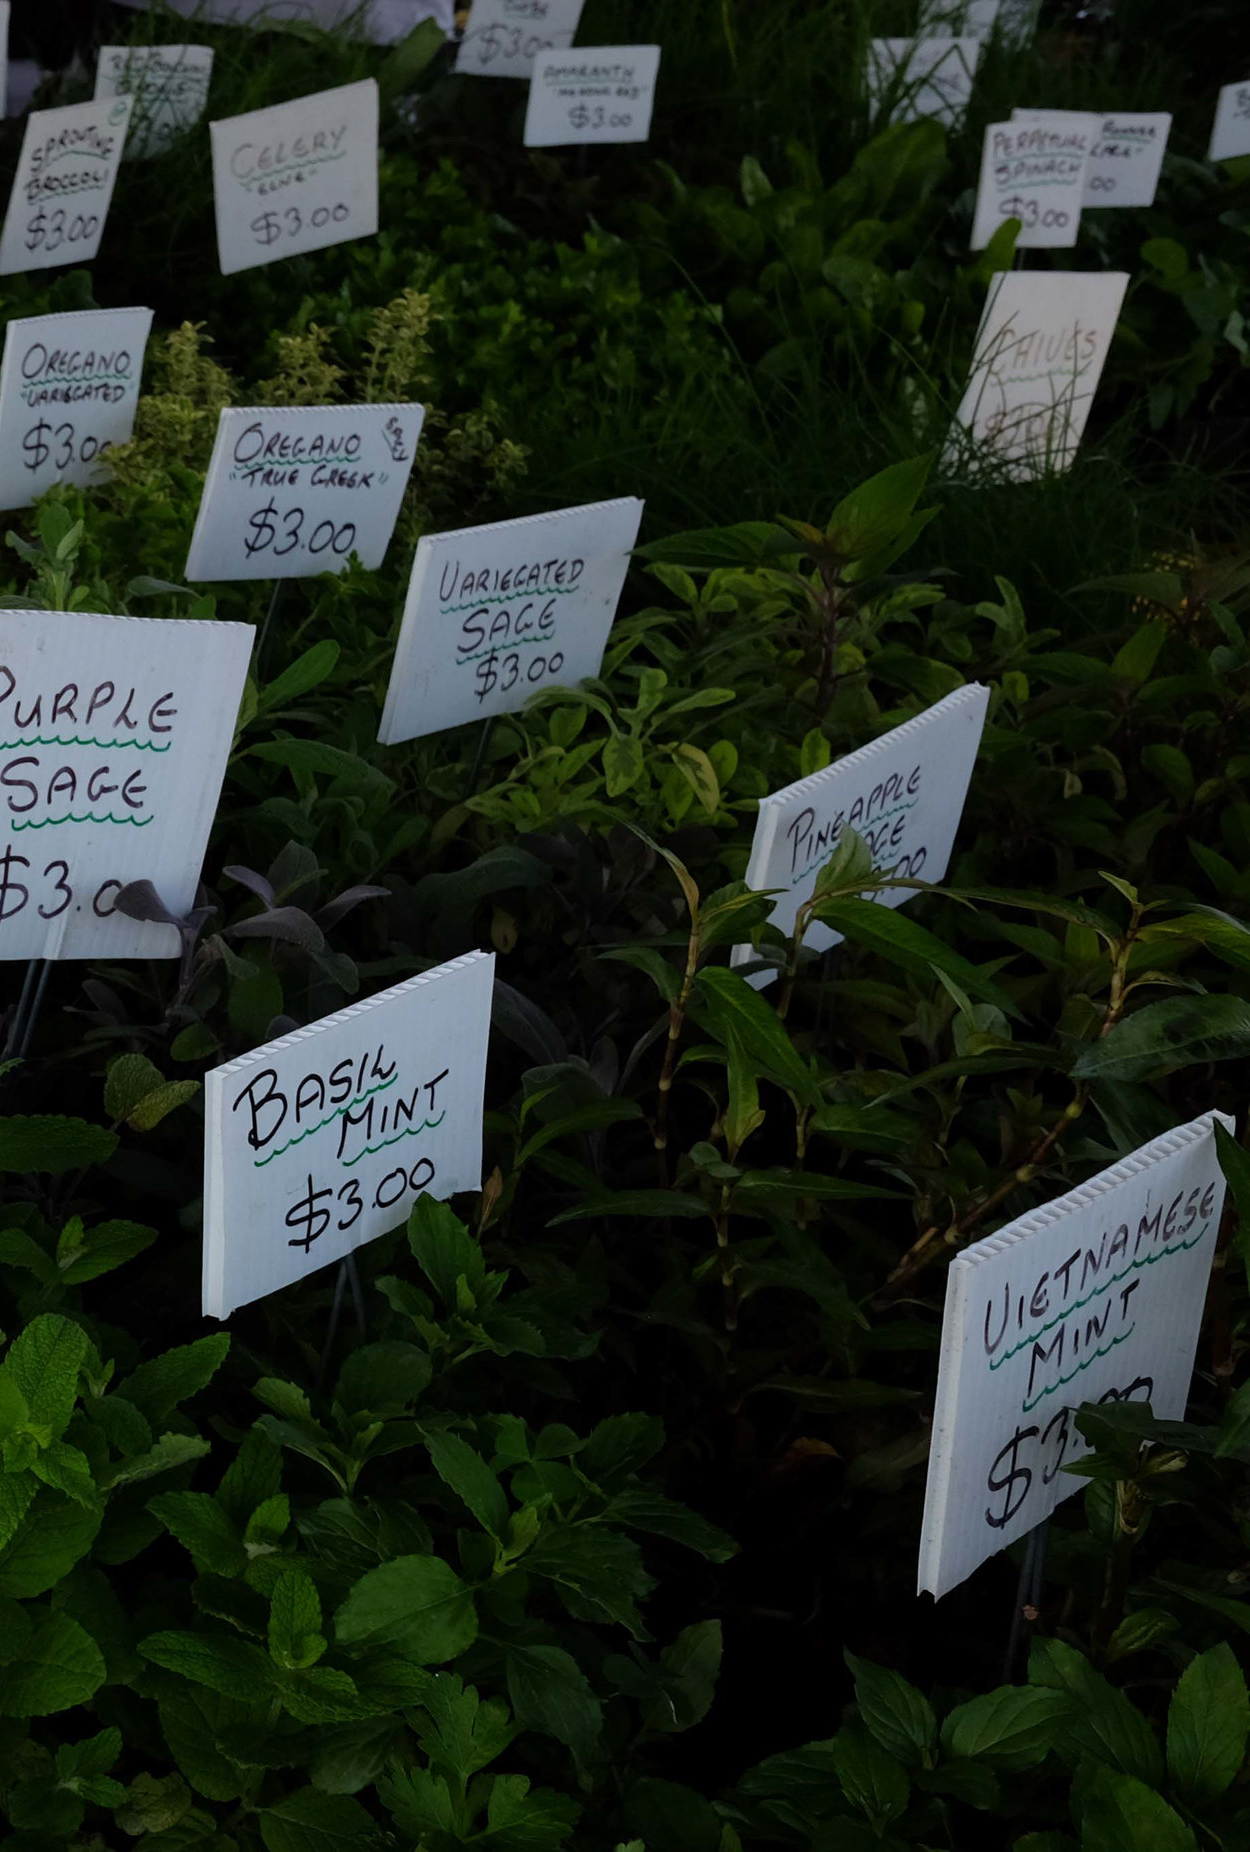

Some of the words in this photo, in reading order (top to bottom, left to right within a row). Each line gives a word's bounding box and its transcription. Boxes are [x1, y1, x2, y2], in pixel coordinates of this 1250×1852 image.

[231, 124, 347, 180] CELERY
[250, 203, 349, 245] $3.00
[21, 343, 131, 381] OREGANO
[234, 422, 361, 463] OREGANO
[244, 496, 357, 559] $3.00
[438, 558, 586, 602] VARIEGATED
[456, 598, 558, 653] SAGE
[473, 650, 566, 705] $3.00
[0, 756, 147, 812] SAGE
[787, 764, 921, 873] PINEAPPLE
[232, 1043, 396, 1151] BASIL
[337, 1068, 449, 1159] MINT
[285, 1157, 435, 1254] $3.00
[983, 1181, 1216, 1355] VIETNAMESE
[1026, 1278, 1140, 1399] MINT
